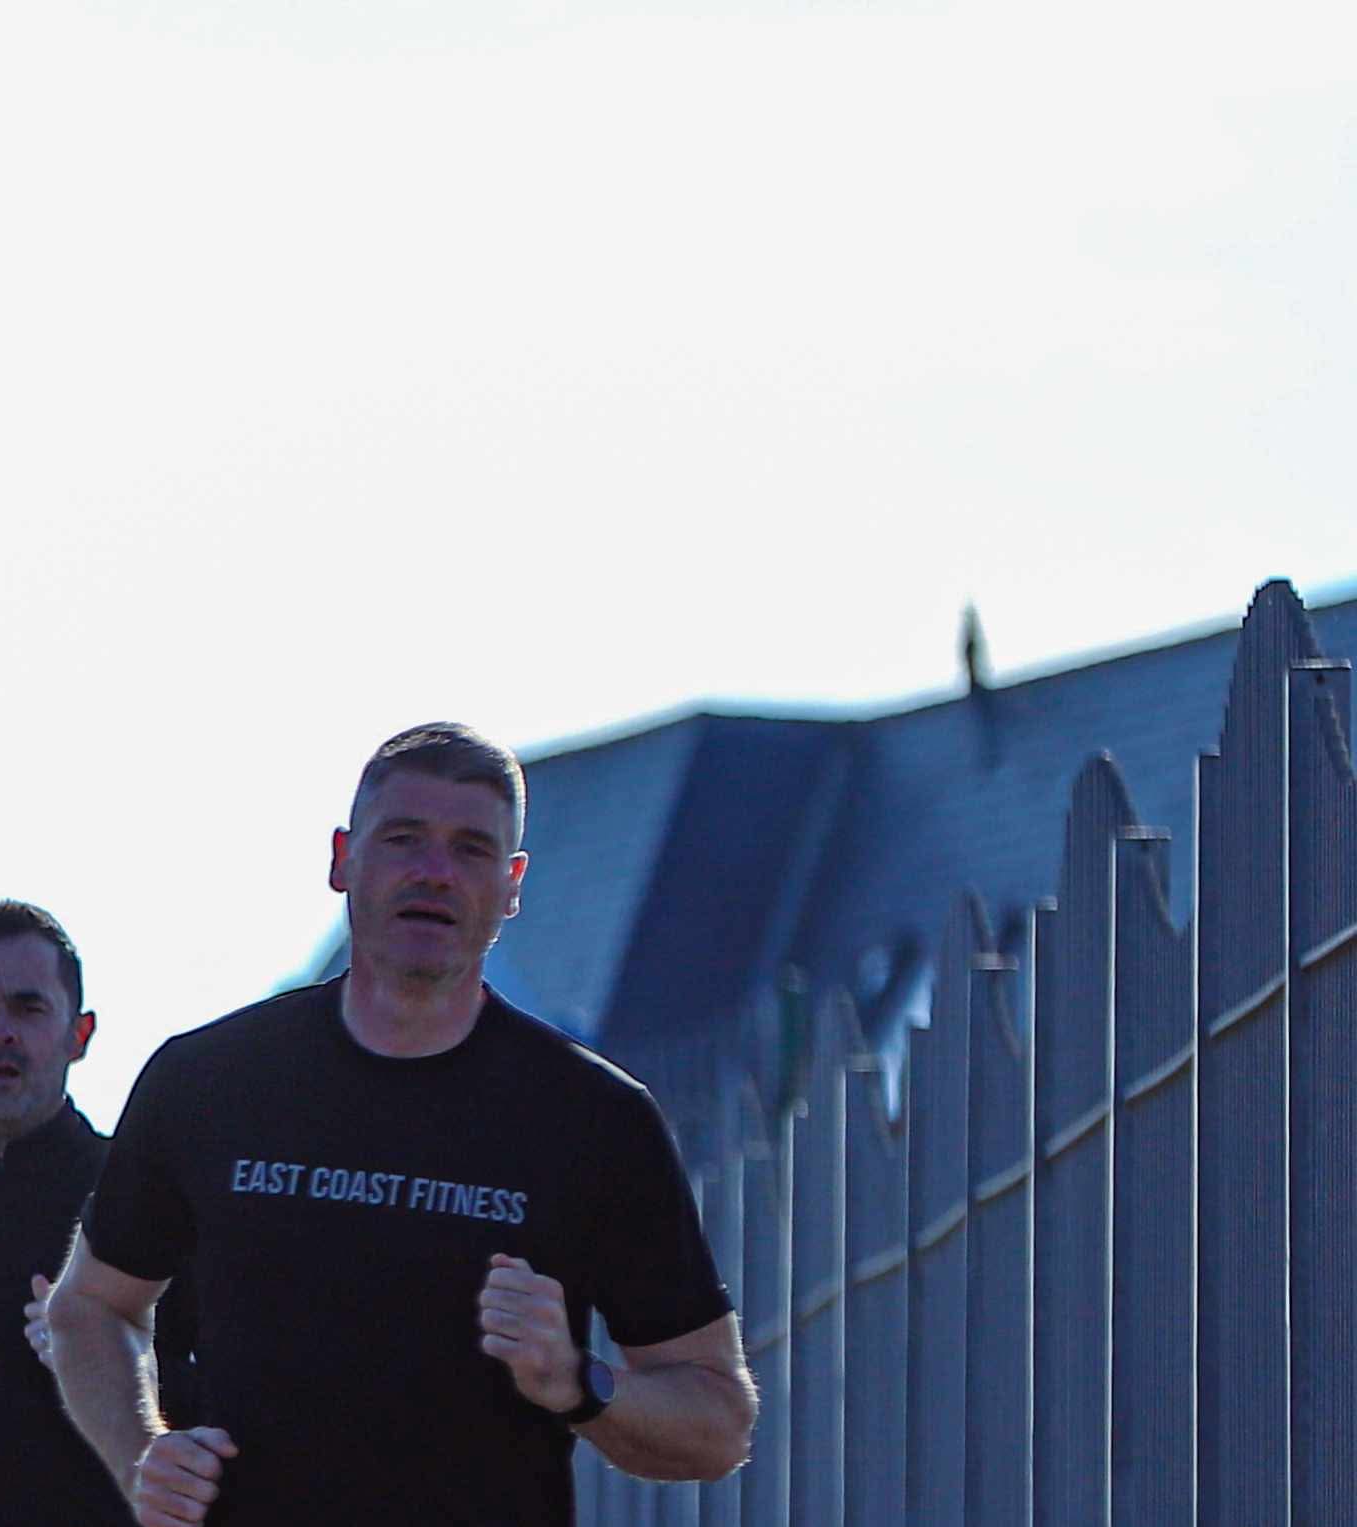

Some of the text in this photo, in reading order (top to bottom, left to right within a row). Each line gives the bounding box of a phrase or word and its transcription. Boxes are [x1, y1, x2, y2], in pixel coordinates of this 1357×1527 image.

[231, 1159, 527, 1225] EAST COAST FITNESS
